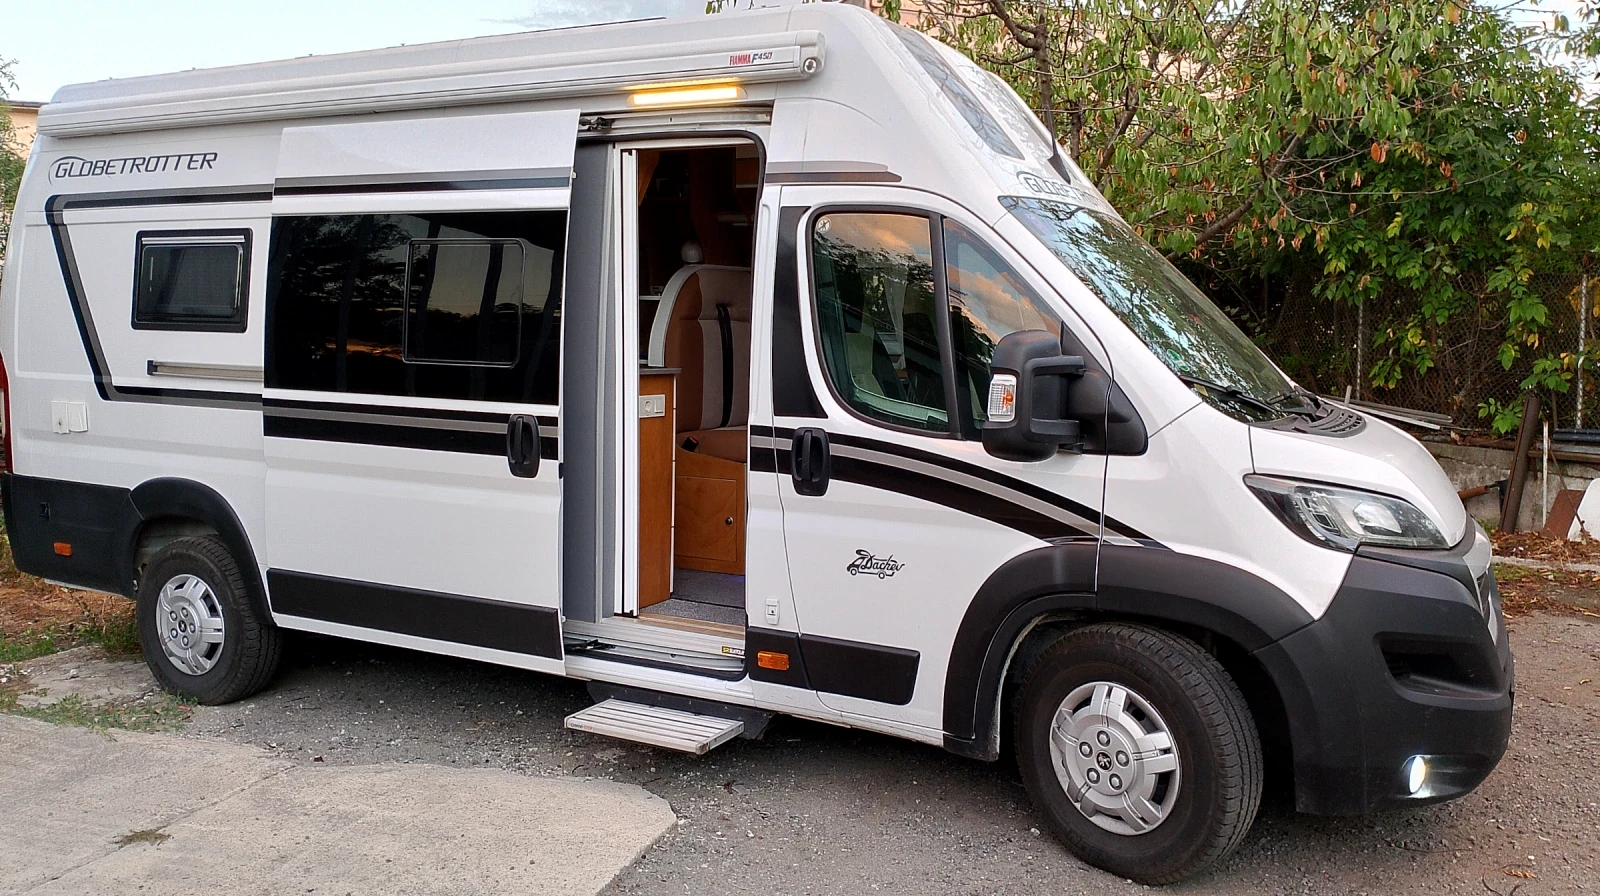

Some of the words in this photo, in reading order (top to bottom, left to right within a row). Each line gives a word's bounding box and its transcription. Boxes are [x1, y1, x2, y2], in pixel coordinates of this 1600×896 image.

[729, 53, 751, 66] FIAMMA
[55, 152, 218, 178] GLOBETROTTER
[858, 550, 905, 571] Dachev
